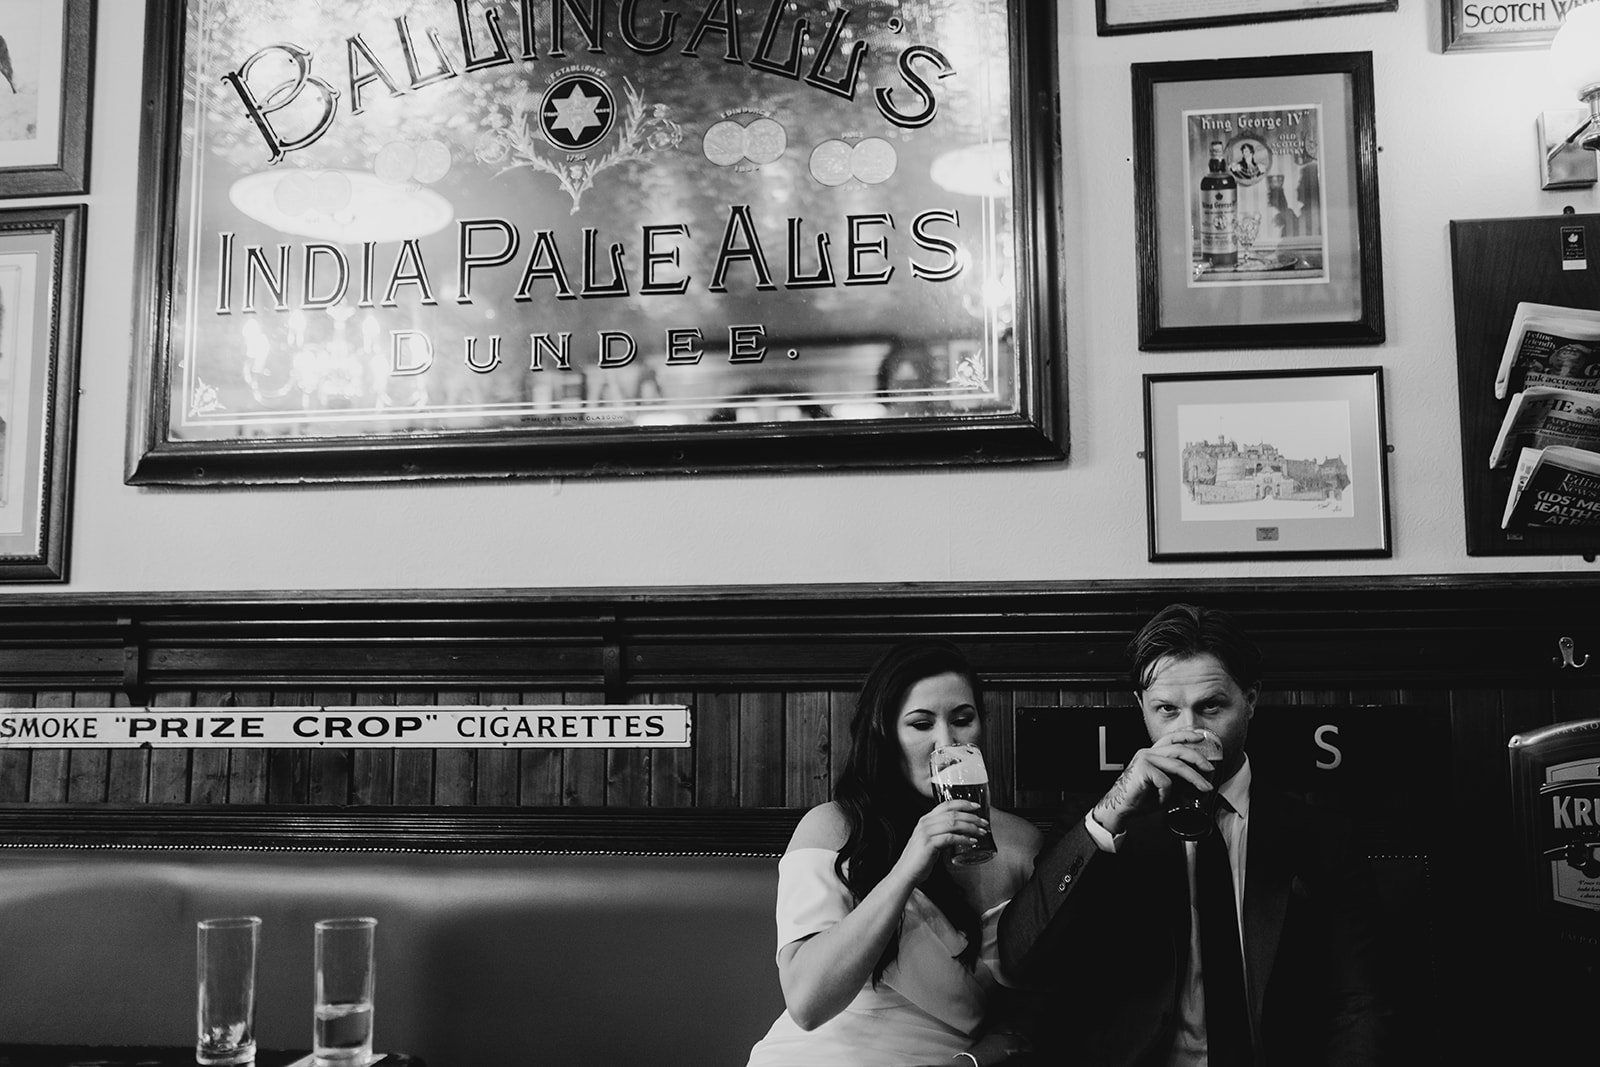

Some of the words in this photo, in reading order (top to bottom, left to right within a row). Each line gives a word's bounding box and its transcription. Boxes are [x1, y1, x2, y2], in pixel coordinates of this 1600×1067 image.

[1464, 2, 1546, 28] SCOTCH
[549, 64, 608, 80] ESTABLISHED
[220, 0, 957, 165] BALLINGALL'S
[1201, 116, 1233, 132] King
[1238, 114, 1282, 130] George
[1271, 140, 1305, 148] SCOTCH
[216, 231, 438, 315] INDIA
[456, 217, 692, 304] PALE
[708, 204, 964, 292] ALES
[1545, 376, 1586, 387] accused
[1558, 482, 1597, 497] News
[0, 717, 98, 738] SMOKE
[456, 715, 665, 738] CIGARETTES
